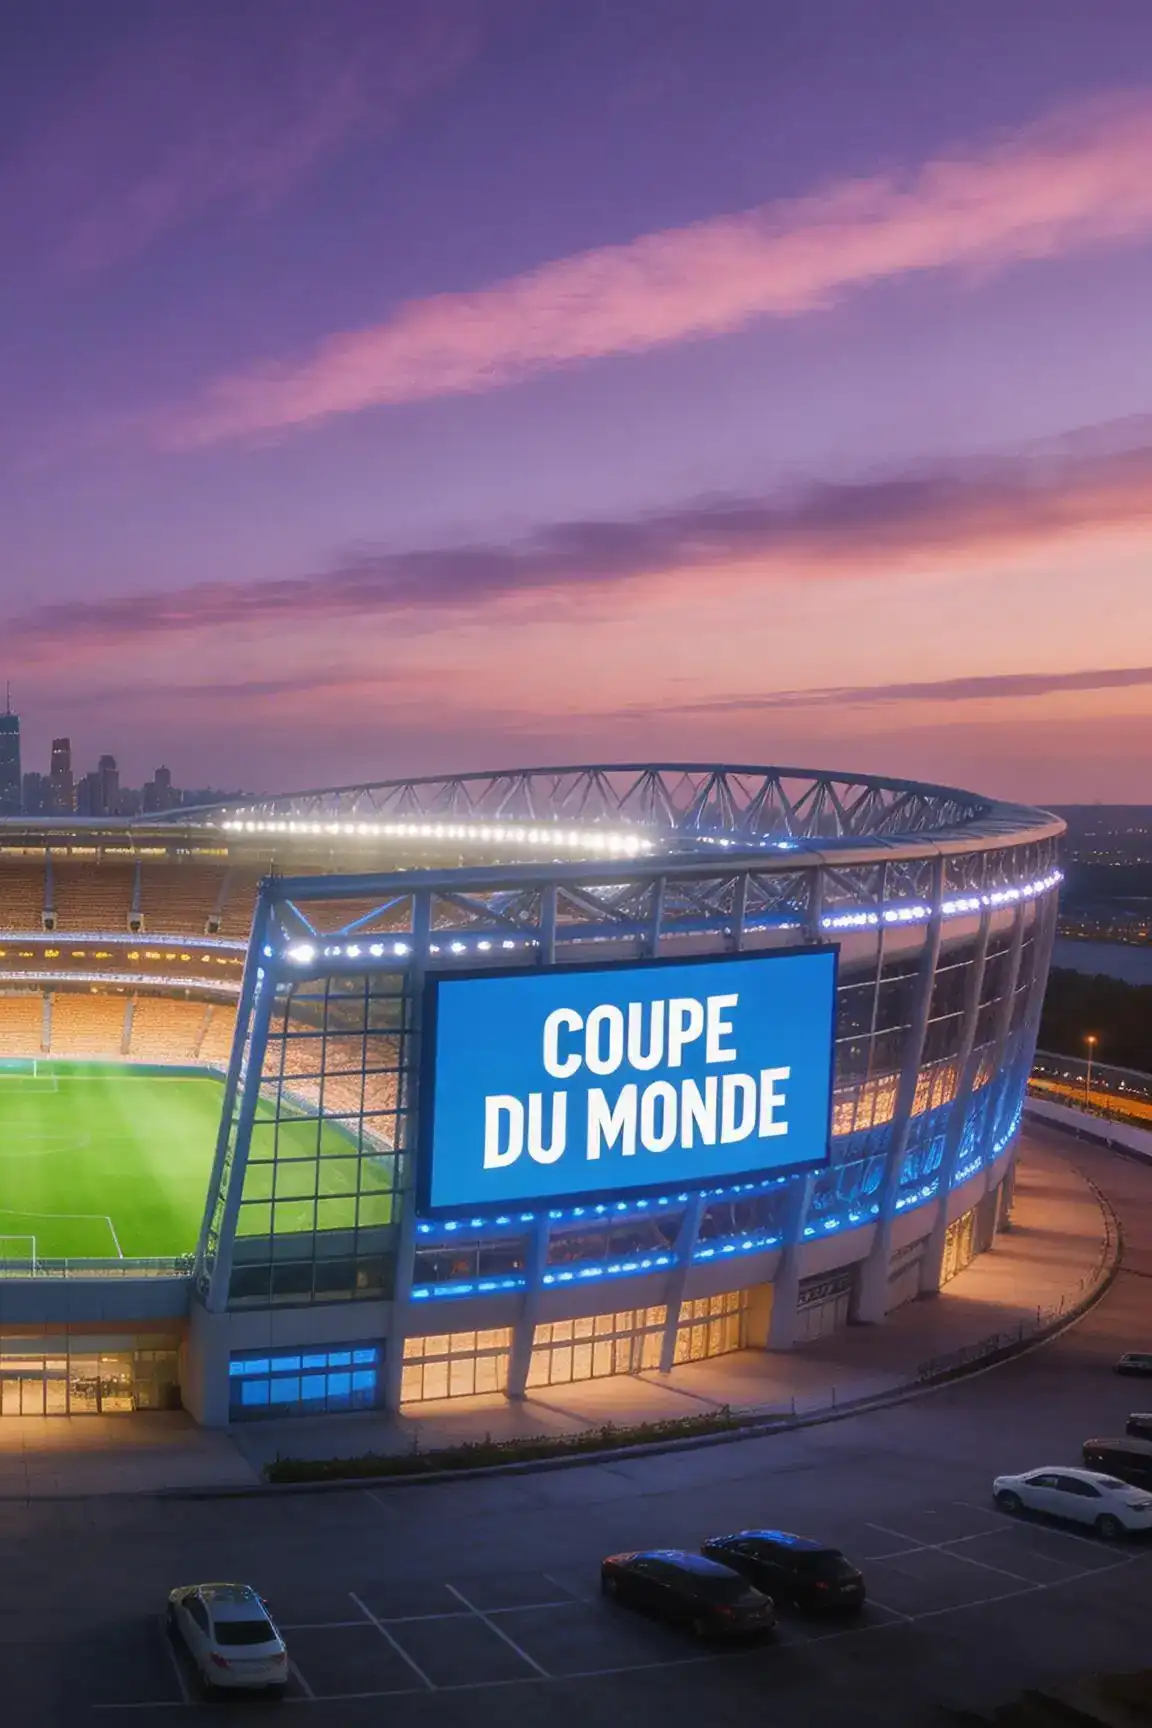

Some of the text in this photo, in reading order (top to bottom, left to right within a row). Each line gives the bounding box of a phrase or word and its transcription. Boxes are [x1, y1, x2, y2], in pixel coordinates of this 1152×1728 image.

[543, 993, 739, 1079] COUPE
[483, 1066, 791, 1169] DU MONDE
